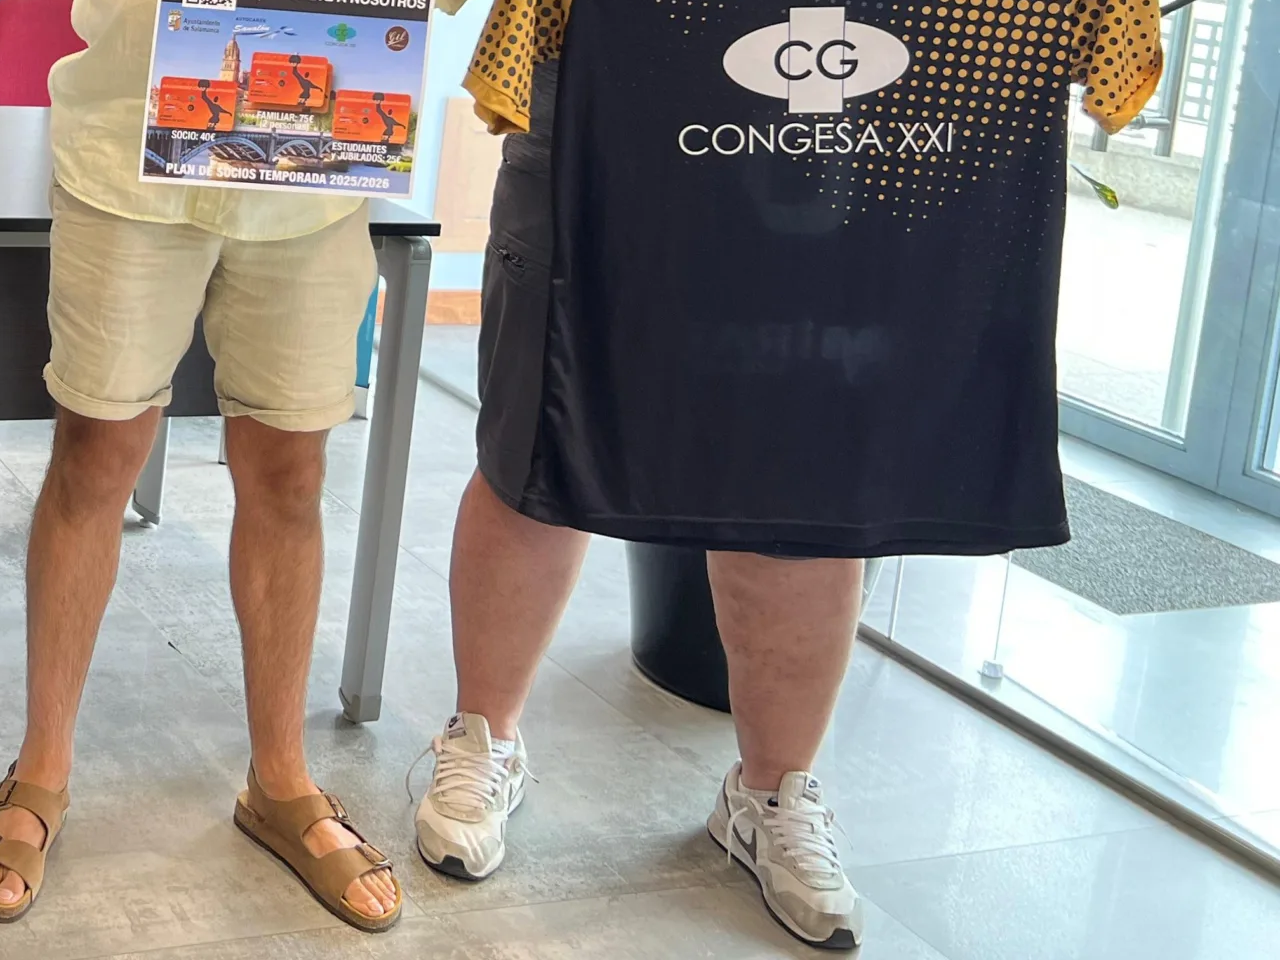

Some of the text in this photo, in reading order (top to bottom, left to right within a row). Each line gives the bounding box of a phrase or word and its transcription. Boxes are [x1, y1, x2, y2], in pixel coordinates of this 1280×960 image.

[183, 17, 221, 27] Ayuntamiento
[190, 25, 220, 34] Salamanca
[775, 39, 859, 81] CG
[256, 111, 315, 123] FAMILIAR: 75€
[171, 129, 216, 142] SOCIO: 40€
[678, 122, 954, 156] CONGESA XXI
[331, 141, 387, 154] ESTUDIANTES
[337, 151, 385, 162] JUBILADOS:
[386, 155, 401, 164] 25€
[165, 162, 390, 189] PLAN DE SOCIOS TEMPORADA 2025/2026
